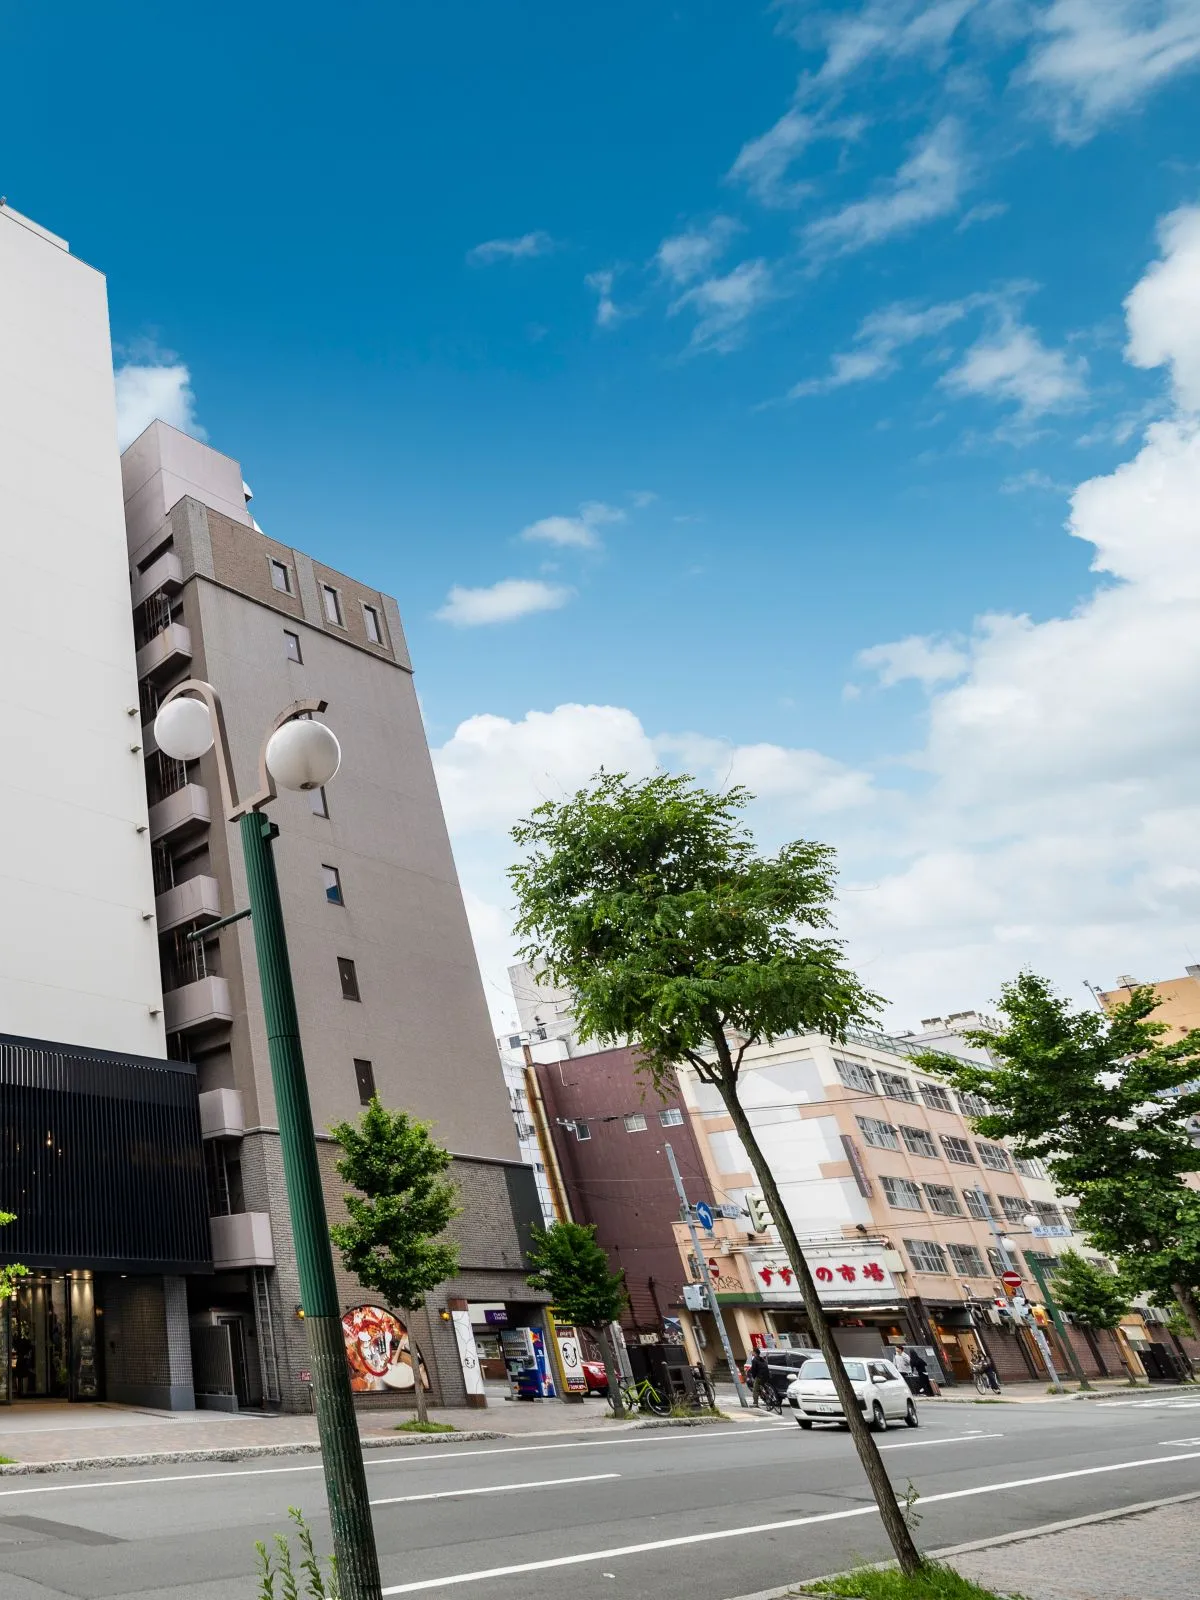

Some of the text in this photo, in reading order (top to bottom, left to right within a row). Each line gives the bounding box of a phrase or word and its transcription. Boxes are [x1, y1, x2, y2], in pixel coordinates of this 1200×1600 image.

[757, 1262, 886, 1287] すすの市場
